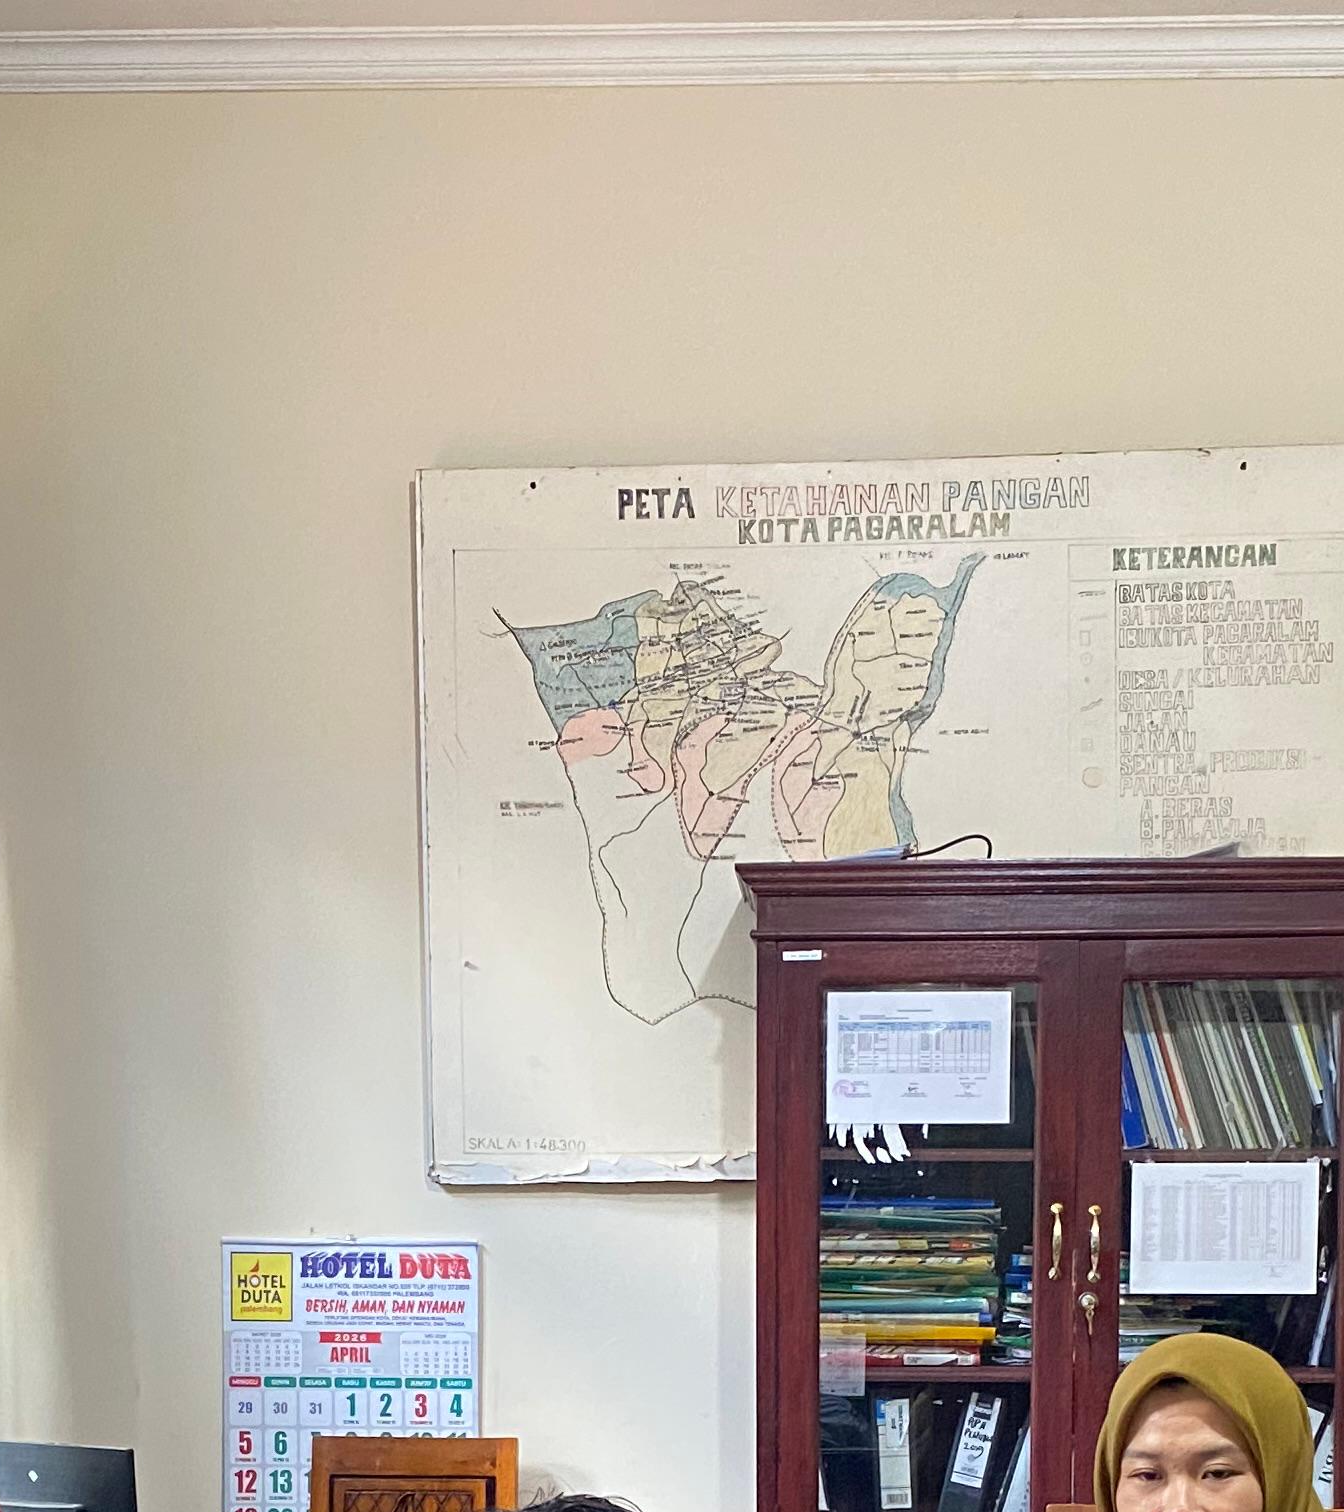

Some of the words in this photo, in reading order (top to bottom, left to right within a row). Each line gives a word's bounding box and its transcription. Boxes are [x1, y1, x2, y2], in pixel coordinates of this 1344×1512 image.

[617, 487, 696, 521] PETA
[715, 483, 931, 519] KETAHANAN
[942, 475, 1090, 512] PANGAN
[738, 516, 820, 545] KOTA
[827, 512, 1011, 543] PAGARALAM
[1113, 543, 1277, 571] KETERANGAN
[1118, 582, 1183, 603] BATAS
[1186, 580, 1236, 601] KOTA
[1119, 603, 1183, 627] BATAS
[1186, 599, 1303, 623] KECAMATAN
[1119, 626, 1197, 648] IBUKOTA
[1203, 642, 1334, 666] KECAMATAN
[1118, 669, 1169, 690] DESA
[1188, 664, 1321, 688] KELURAHAN
[1119, 690, 1194, 712] SUNGAI
[1120, 711, 1188, 733] JALAN
[1120, 731, 1197, 753] DANAU
[300, 1251, 393, 1279] HOTEL
[399, 1252, 472, 1280] DUTA
[238, 1274, 286, 1288] HOTEL
[241, 1289, 282, 1303] DUTA
[305, 1299, 348, 1313] BERSIH,
[352, 1299, 387, 1315] AMAN,
[392, 1300, 415, 1313] DAN
[417, 1300, 465, 1314] NYAMAN
[334, 1333, 367, 1342] 2026
[330, 1347, 371, 1363] APRIL
[238, 1401, 253, 1413] 29
[273, 1402, 288, 1414] 30
[309, 1402, 322, 1414] 31
[346, 1393, 356, 1417] 1
[379, 1393, 392, 1417] 2
[414, 1393, 427, 1417] 3
[449, 1394, 463, 1417] 4
[239, 1431, 252, 1455] 5
[274, 1431, 287, 1455] 6
[234, 1470, 257, 1493] 12
[269, 1470, 292, 1493] 13
